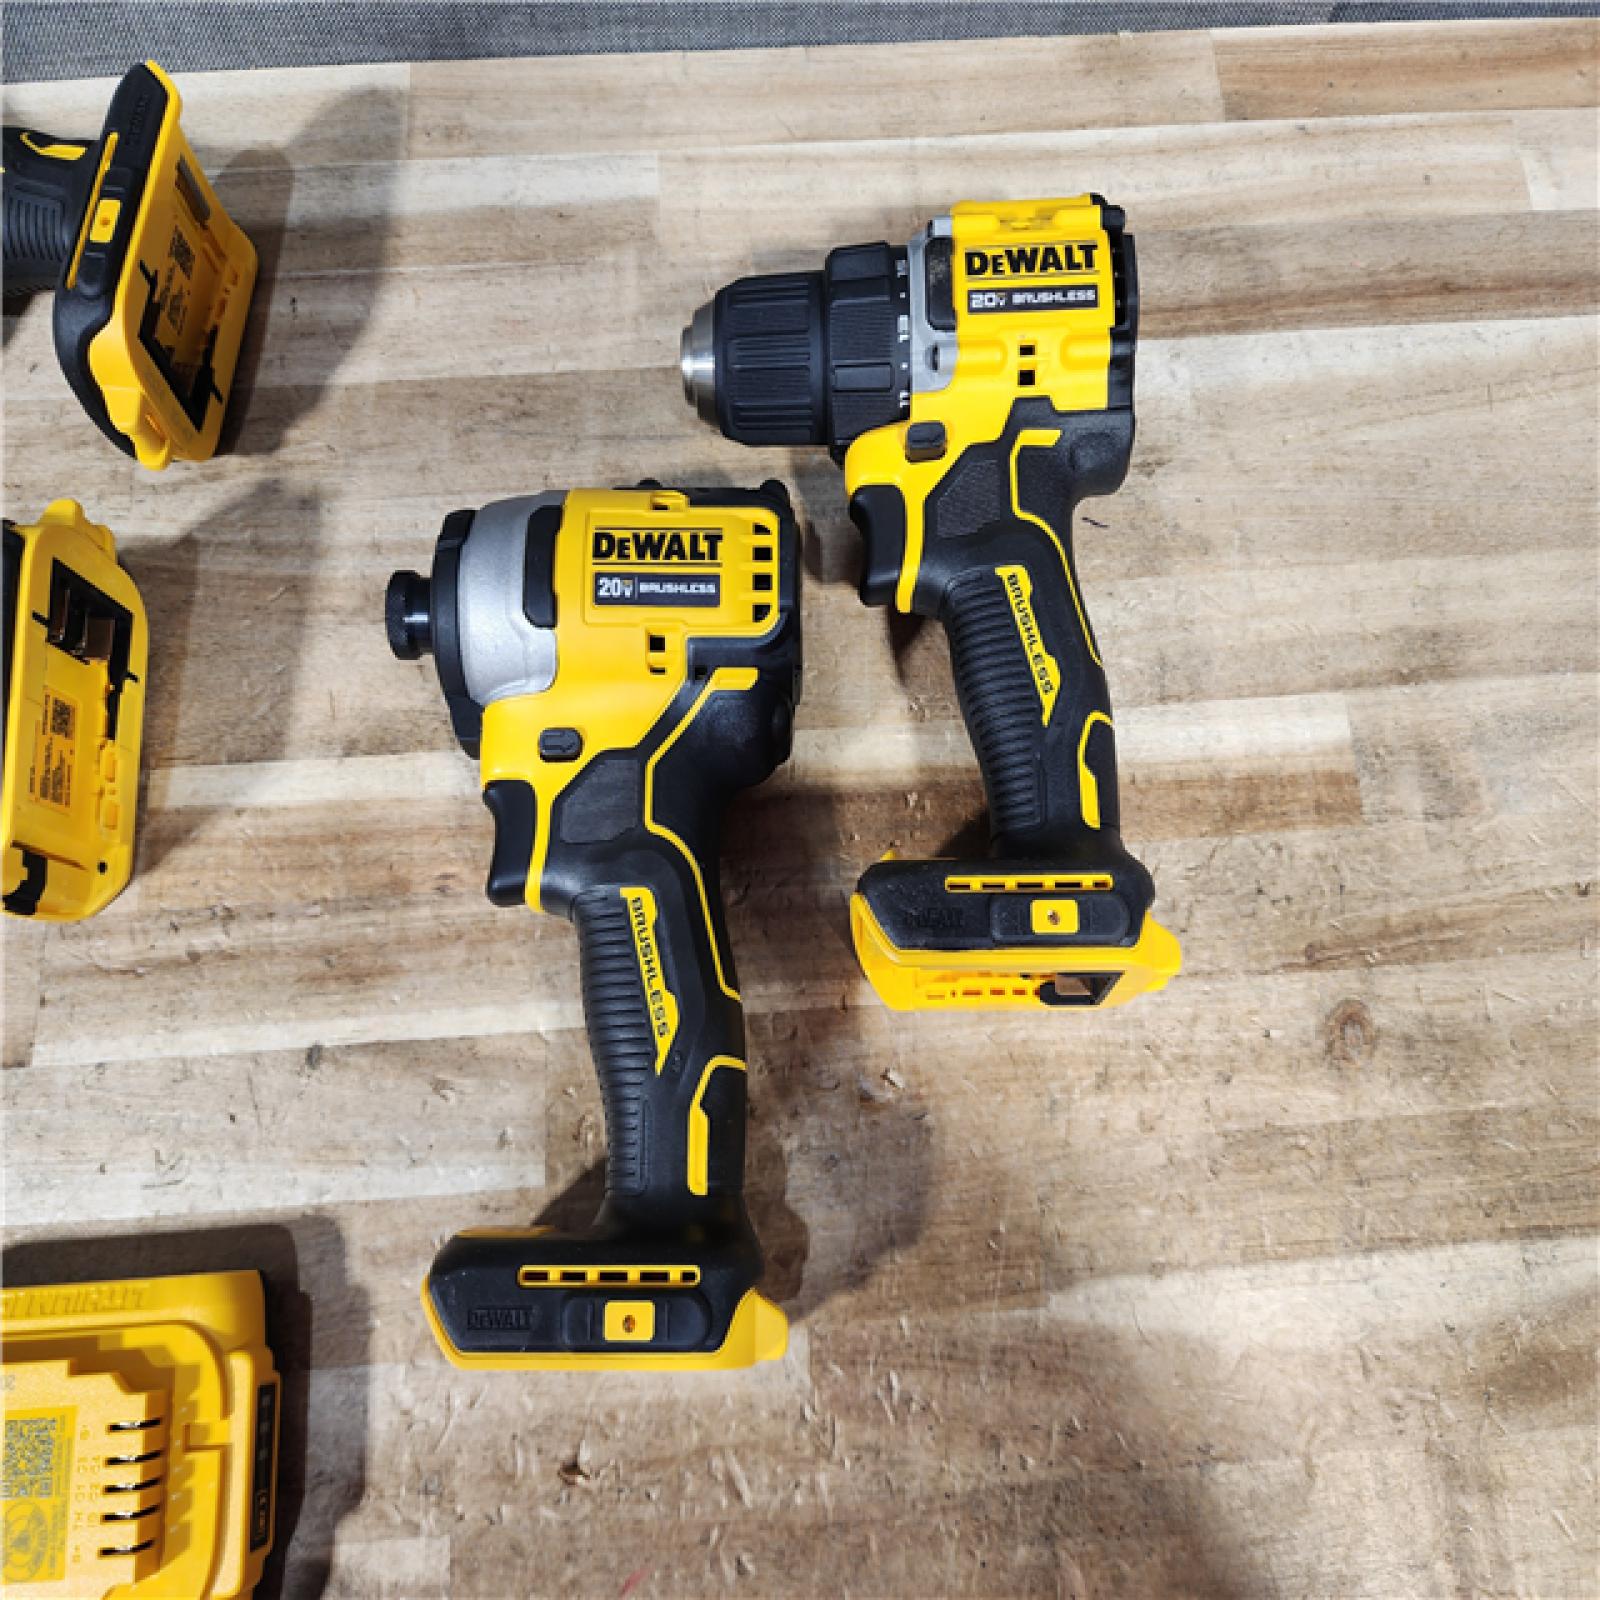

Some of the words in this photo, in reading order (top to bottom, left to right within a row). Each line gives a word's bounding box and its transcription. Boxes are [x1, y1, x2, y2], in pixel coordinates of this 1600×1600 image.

[1012, 288, 1096, 306] BRUSHLESS
[639, 581, 717, 594] BRUSHLESS
[1007, 573, 1053, 695] BRUSHLESS
[632, 897, 671, 1038] BRUSHLESS
